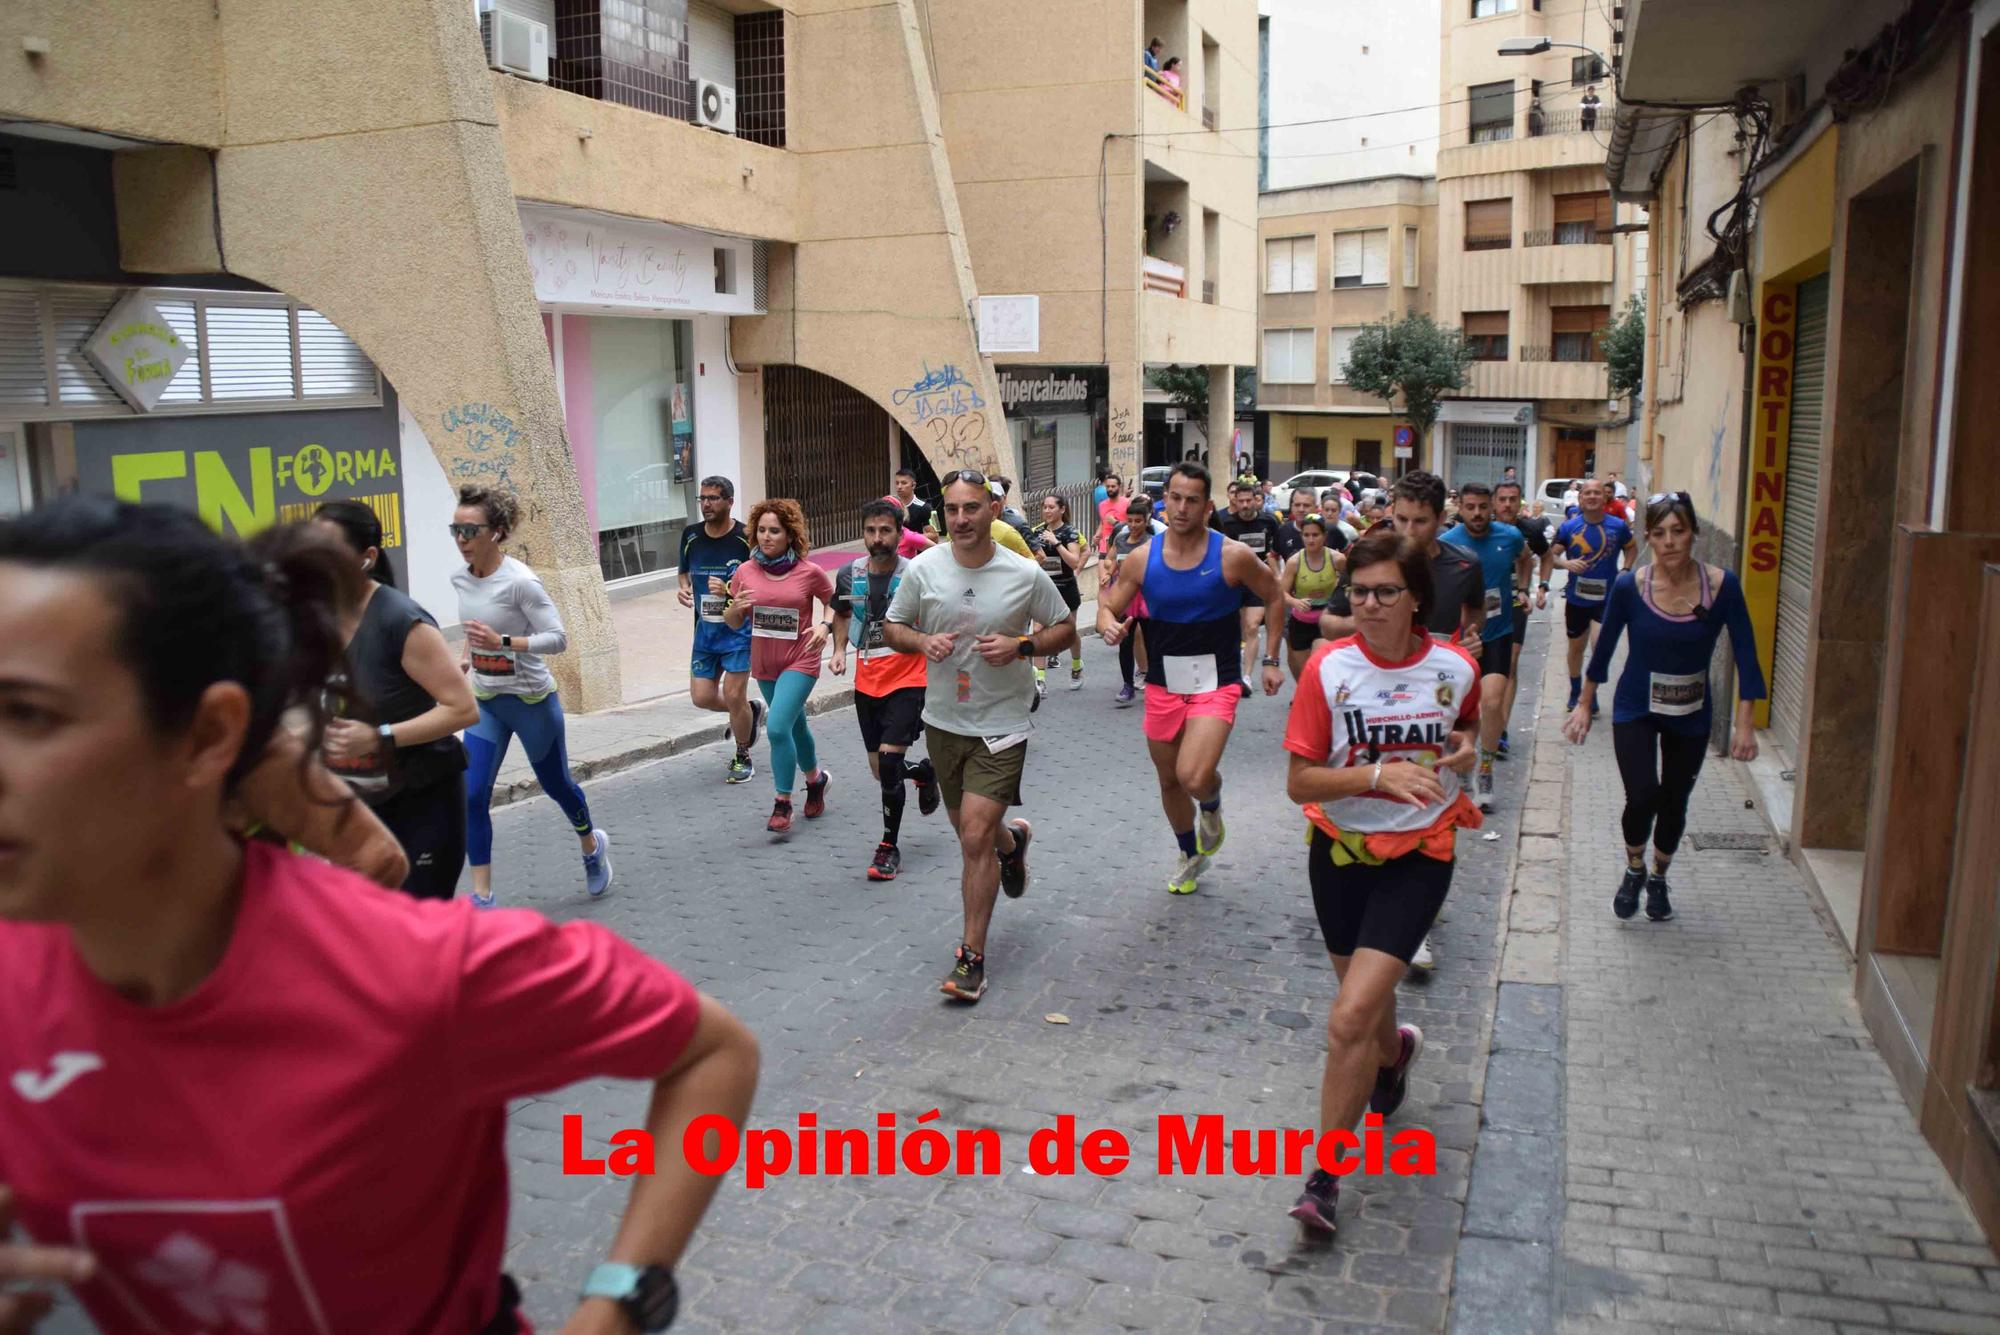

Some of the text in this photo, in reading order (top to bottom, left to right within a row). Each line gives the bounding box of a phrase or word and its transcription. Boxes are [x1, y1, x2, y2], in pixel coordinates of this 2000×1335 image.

[997, 373, 1088, 410] Hipercalzados
[1750, 294, 1793, 572] CORTINAS
[277, 444, 396, 496] FORMA
[1368, 722, 1446, 746] TRAIL
